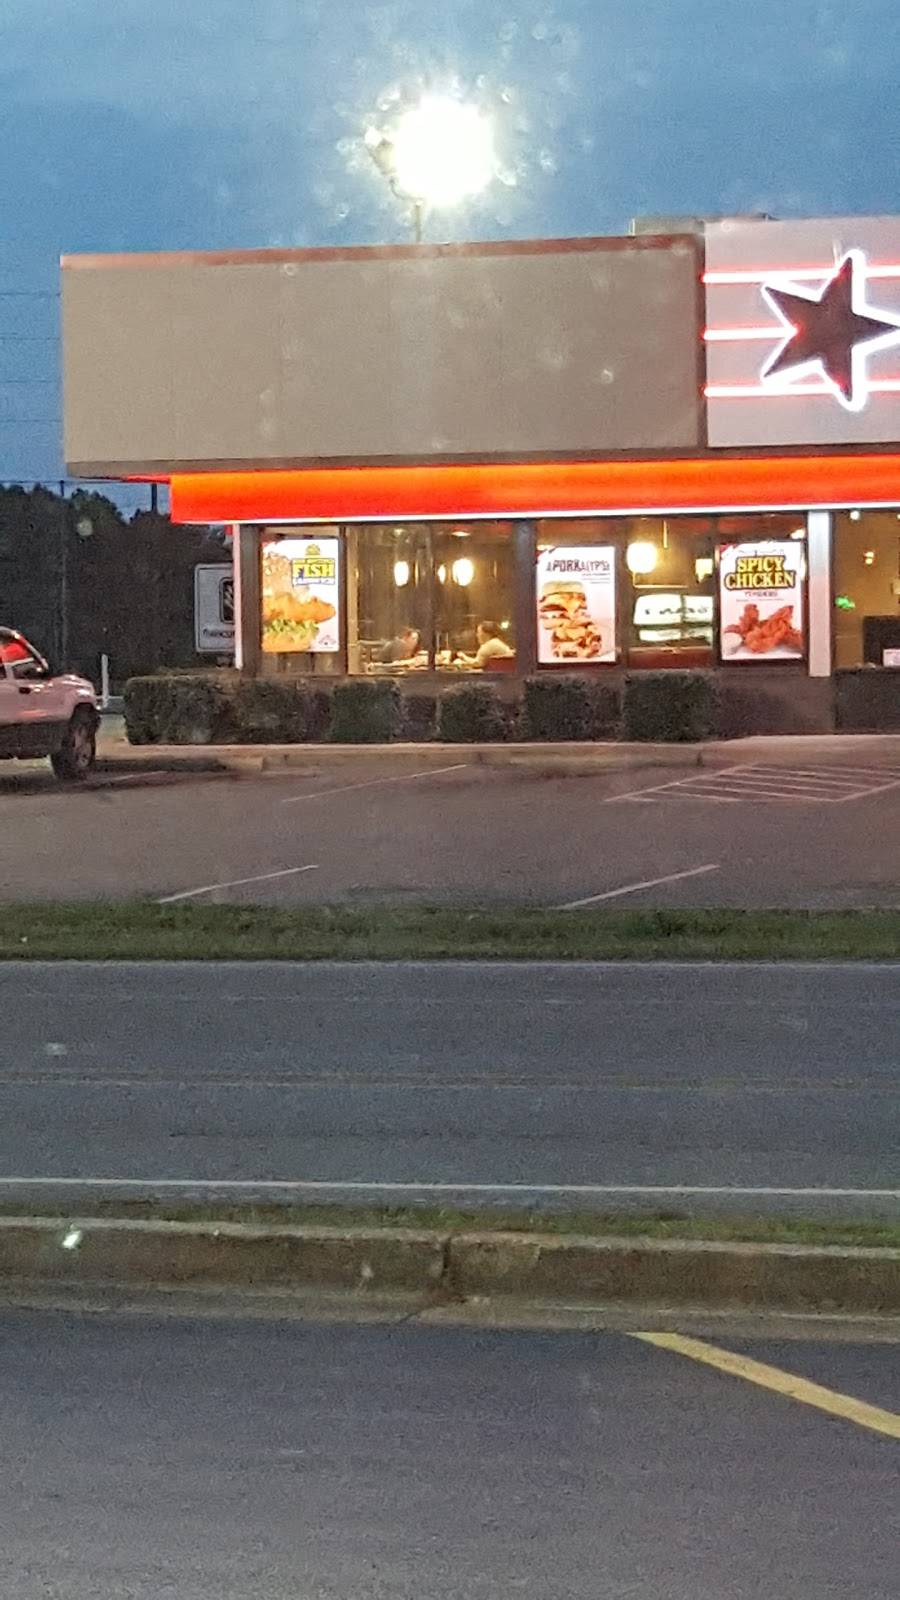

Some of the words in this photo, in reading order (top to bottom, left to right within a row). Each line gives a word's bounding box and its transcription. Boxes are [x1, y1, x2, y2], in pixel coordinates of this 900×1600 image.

[292, 562, 334, 578] FISH
[736, 556, 785, 573] SPICY
[725, 571, 795, 590] CHICKEN
